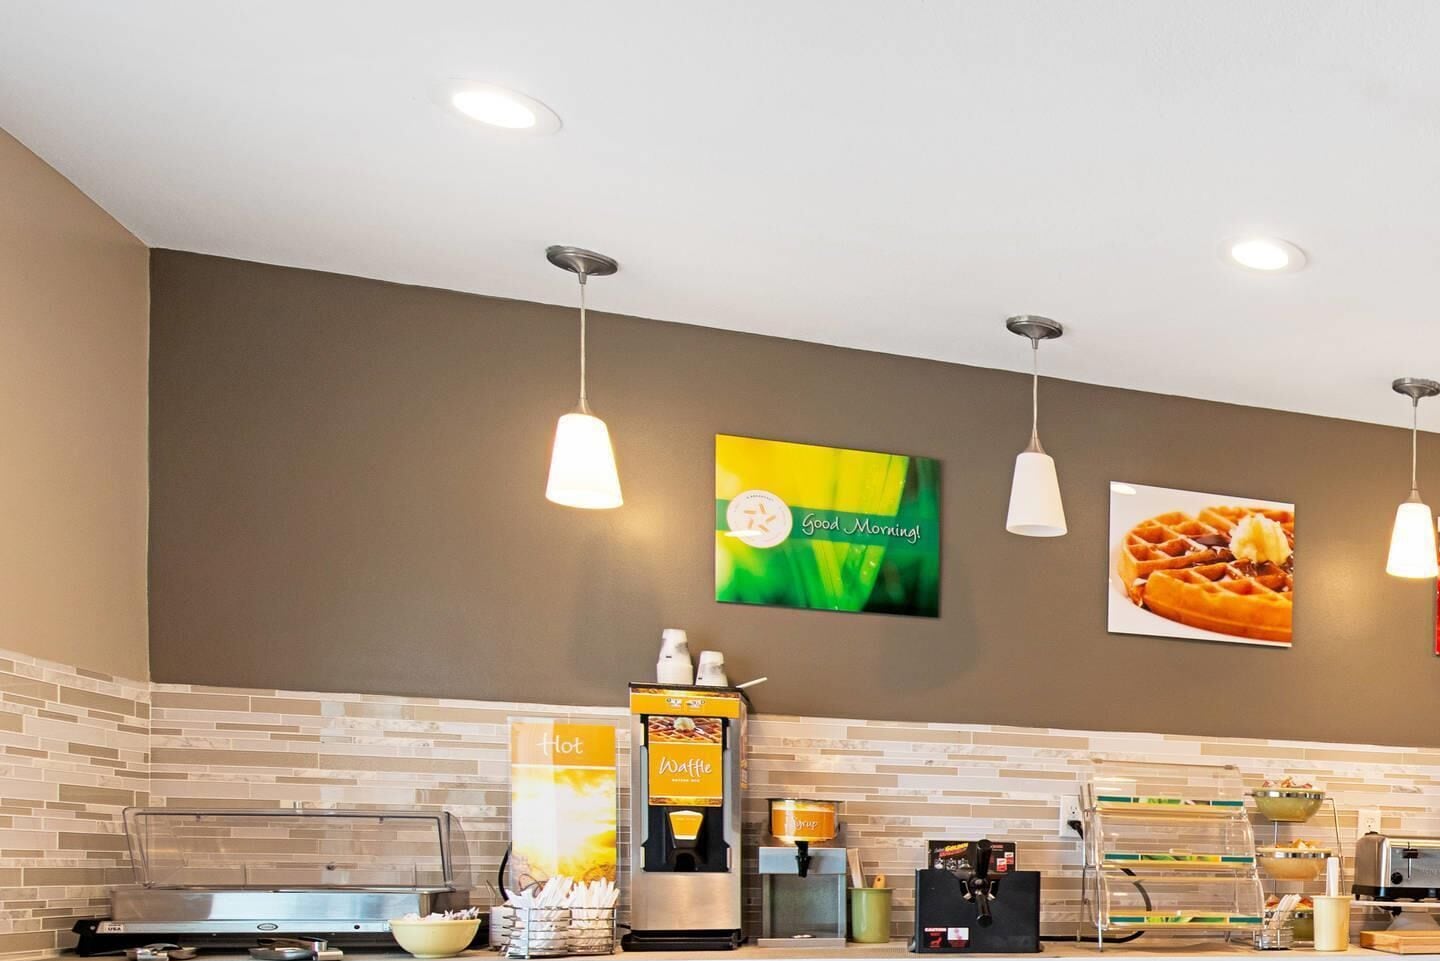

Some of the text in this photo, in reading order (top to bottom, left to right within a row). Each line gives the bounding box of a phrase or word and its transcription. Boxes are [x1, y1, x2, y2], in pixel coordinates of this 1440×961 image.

[801, 513, 921, 544] Good Morning!
[535, 732, 584, 756] Hot
[658, 756, 713, 778] Waffle
